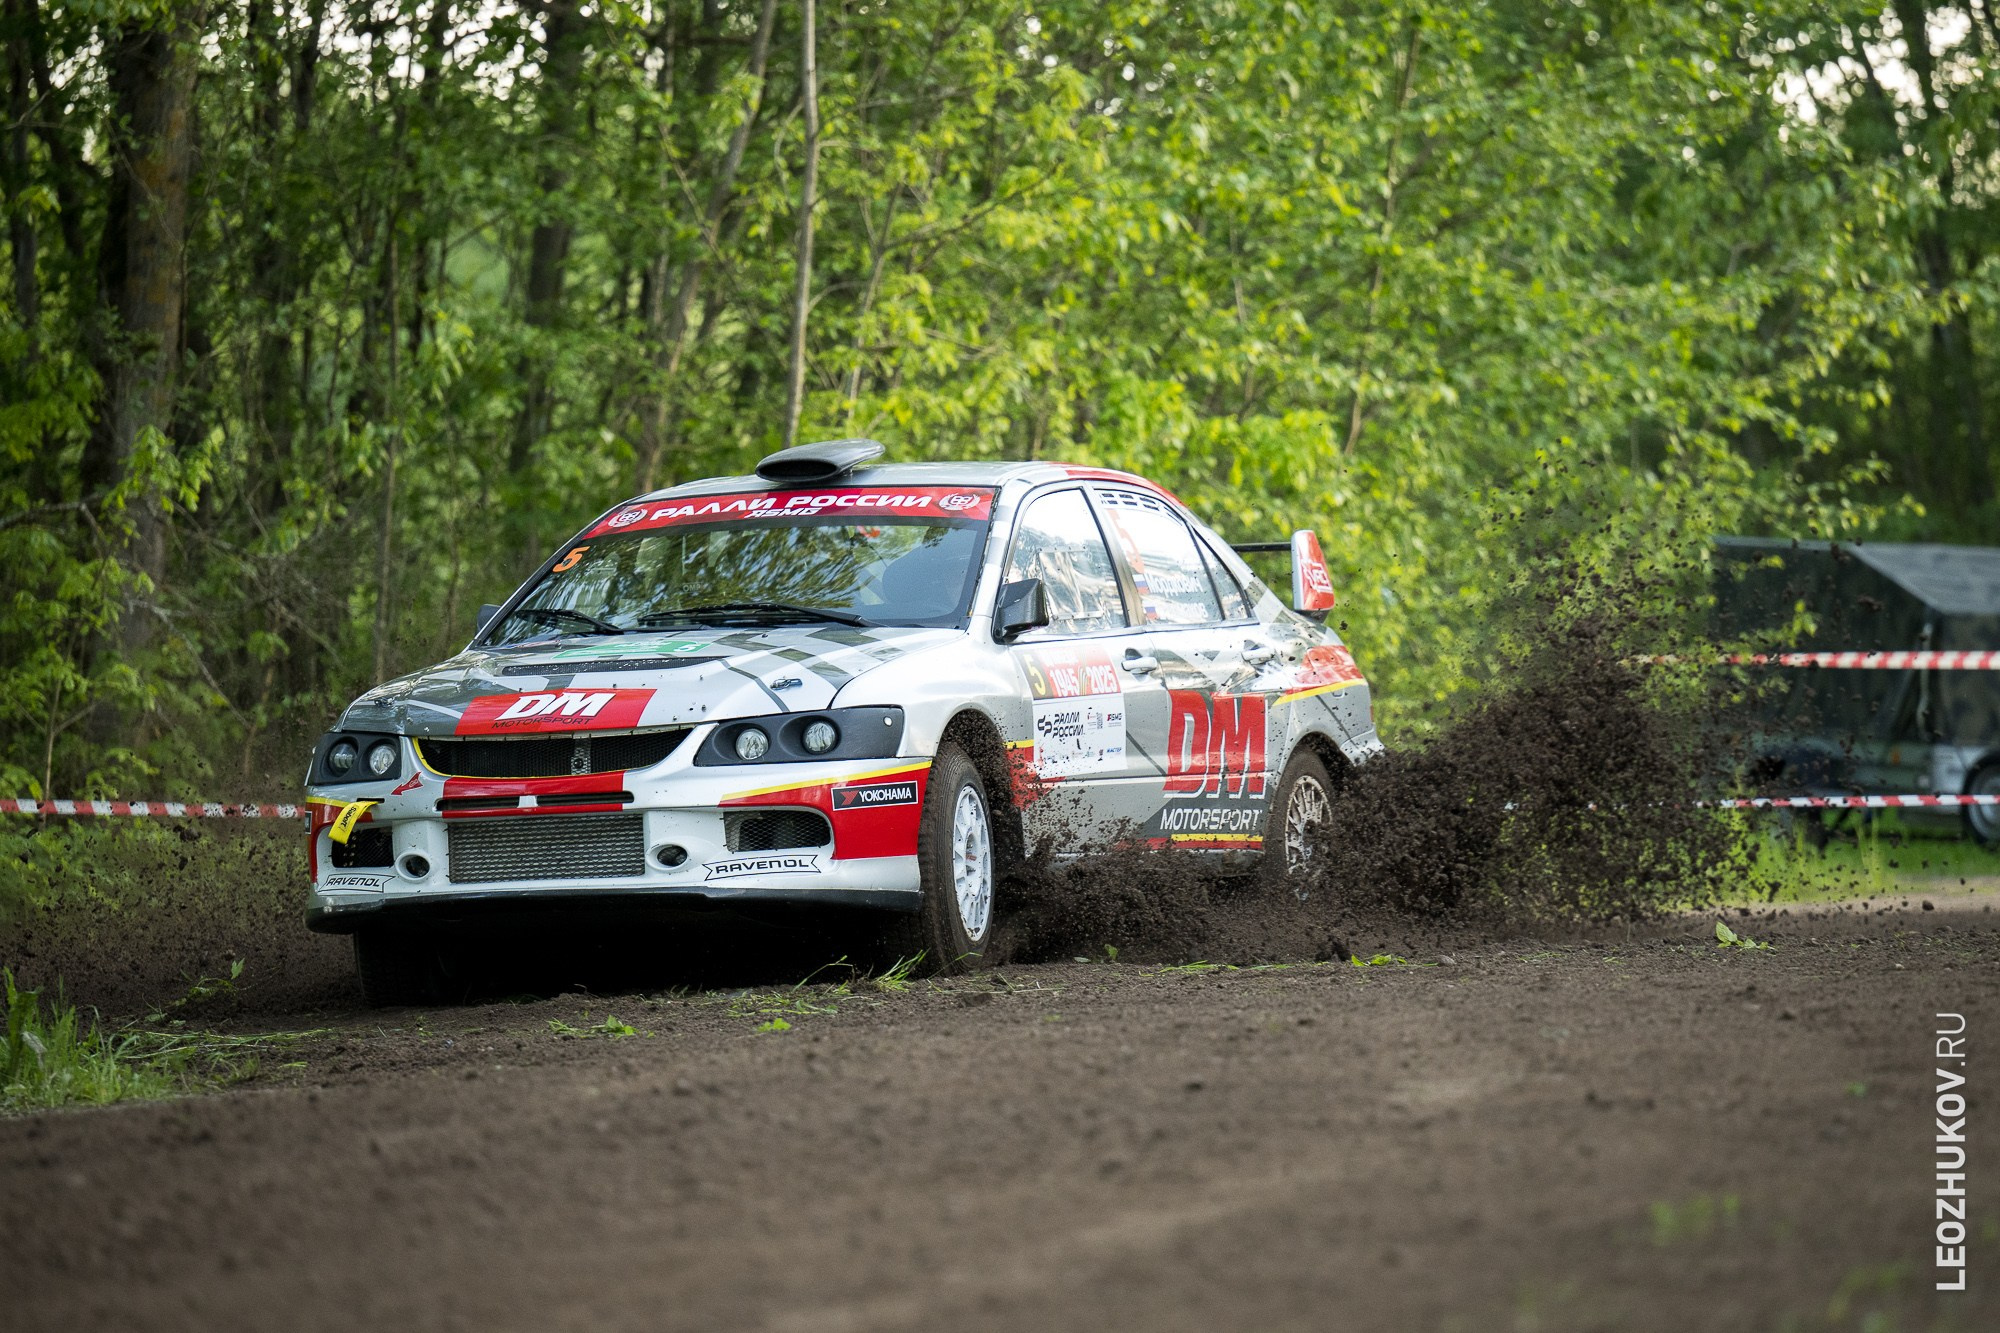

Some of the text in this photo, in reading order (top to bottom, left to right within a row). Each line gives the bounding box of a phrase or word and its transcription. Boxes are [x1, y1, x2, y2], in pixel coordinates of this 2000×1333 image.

[650, 494, 932, 520] РАЛЛИ РОССИИ
[552, 546, 590, 572] 5
[1023, 654, 1046, 695] 5
[1050, 665, 1118, 697] 1945 2025
[494, 692, 617, 721] DM
[492, 716, 594, 729] MOTORSPORT
[1053, 711, 1080, 726] РАЛЛИ
[1052, 724, 1084, 739] РОССИИ
[1162, 689, 1268, 799] DM
[859, 787, 912, 802] YOKOHAMA
[341, 806, 357, 828] Sabelt
[1160, 808, 1262, 830] MOTORSPORT
[715, 859, 809, 874] RAVENOL
[326, 877, 380, 887] RAVENOL
